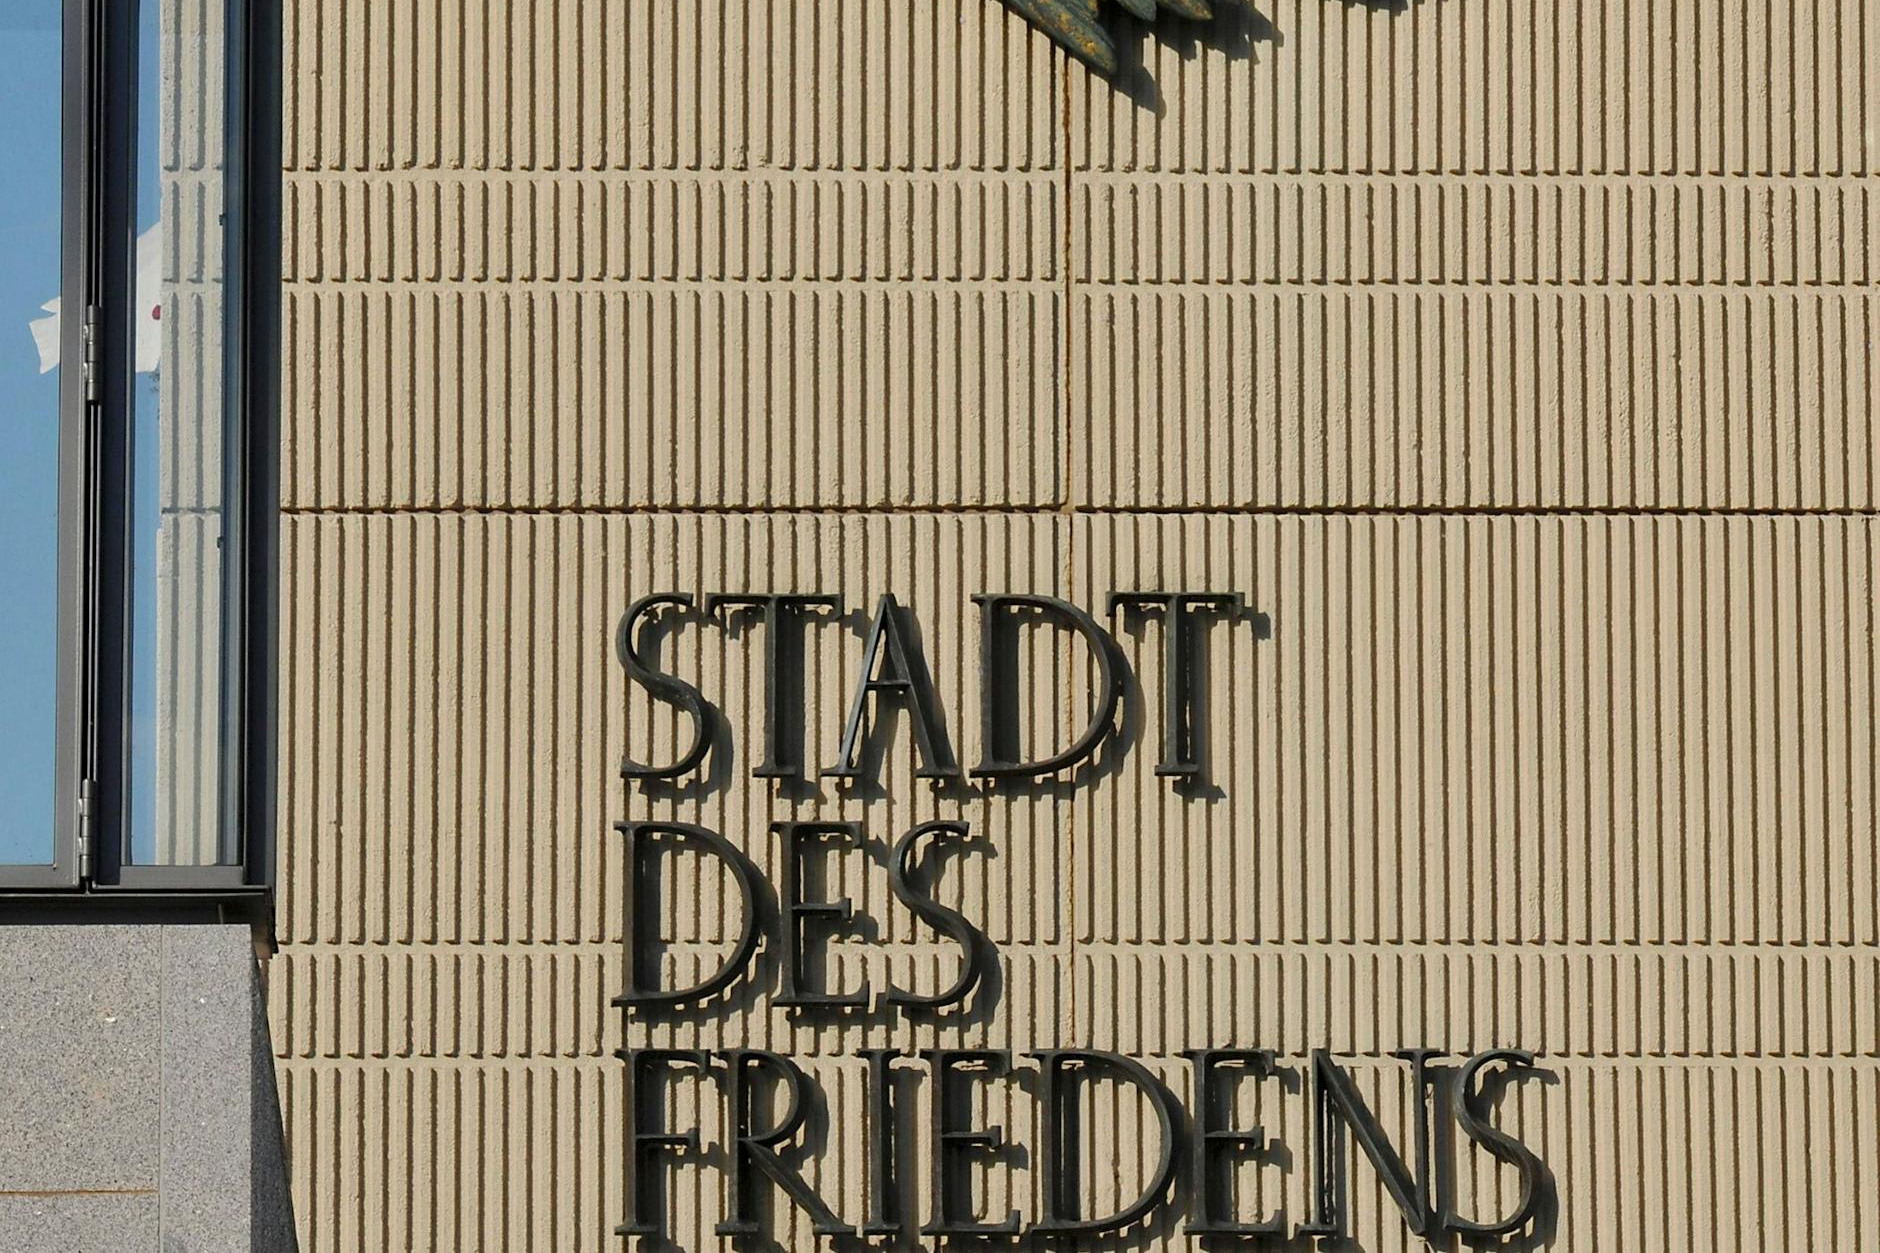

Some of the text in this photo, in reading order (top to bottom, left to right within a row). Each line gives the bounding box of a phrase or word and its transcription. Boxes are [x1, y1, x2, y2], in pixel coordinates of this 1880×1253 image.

[616, 591, 1246, 779] STADT
[611, 820, 981, 1008] DES
[614, 1047, 1536, 1237] FRIEDENS
